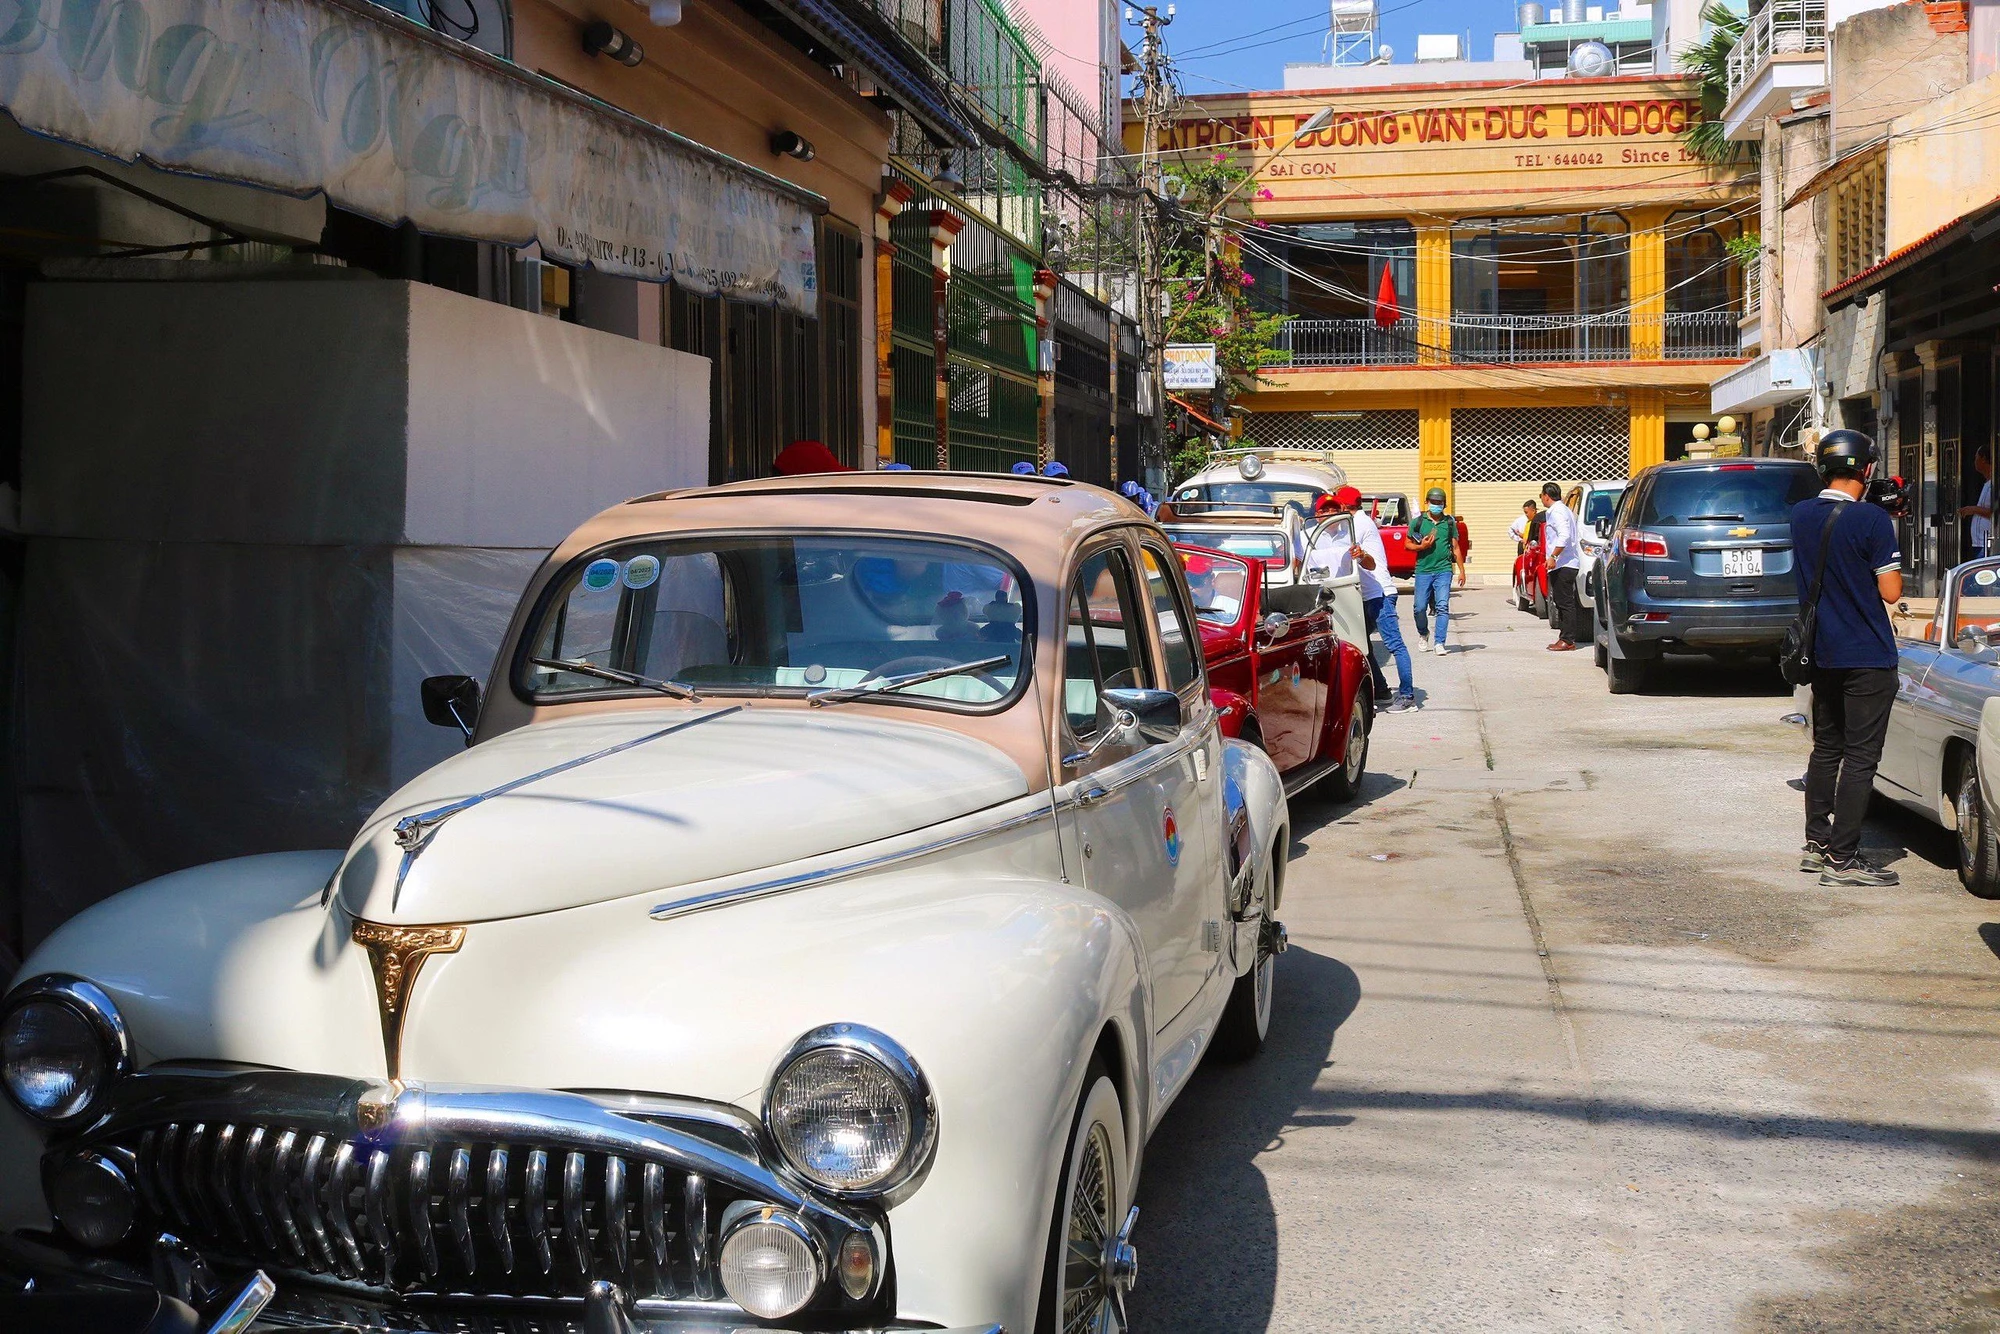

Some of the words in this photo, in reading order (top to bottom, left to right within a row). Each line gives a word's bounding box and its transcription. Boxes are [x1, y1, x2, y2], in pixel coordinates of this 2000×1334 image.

[1554, 153, 1603, 165] 644042
[1621, 149, 1669, 163] Since
[1270, 164, 1294, 176] SAI
[1301, 162, 1336, 175] GON
[1731, 550, 1753, 562] 51G
